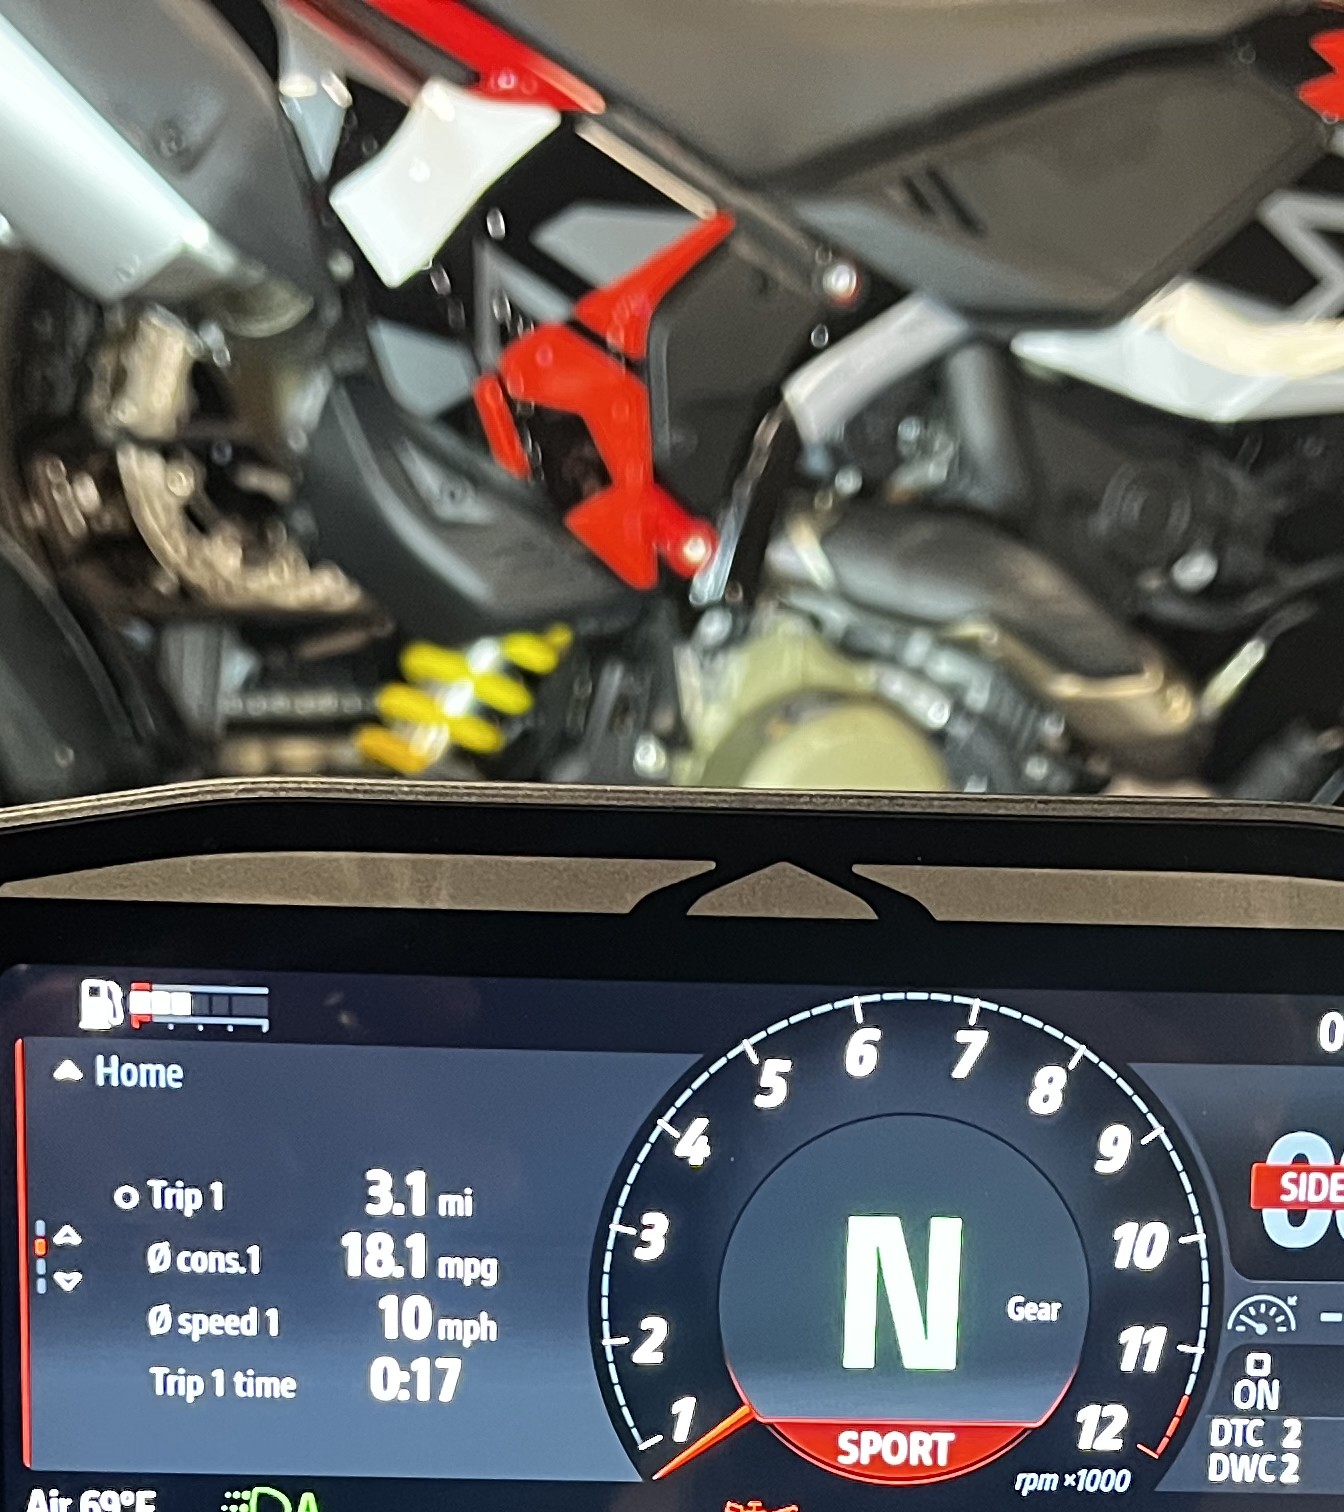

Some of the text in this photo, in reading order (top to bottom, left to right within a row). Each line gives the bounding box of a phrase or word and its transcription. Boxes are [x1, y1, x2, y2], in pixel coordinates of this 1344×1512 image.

[95, 1054, 184, 1089] Home
[845, 1027, 882, 1079] 6
[950, 1029, 990, 1079] 7
[753, 1057, 793, 1110] 5
[1027, 1065, 1068, 1115] 8
[675, 1117, 712, 1167] 4
[1093, 1123, 1132, 1174] 9
[146, 1178, 223, 1218] Trip 1
[364, 1168, 473, 1217] 3.1 mi
[176, 1244, 260, 1275] cons.1
[341, 1231, 498, 1288] 18.1 mpg
[633, 1211, 670, 1262] 3
[1113, 1221, 1172, 1271] 10
[842, 1215, 963, 1371] N
[1006, 1295, 1062, 1322] Gear
[177, 1306, 258, 1343] speed
[264, 1307, 279, 1337] 1
[378, 1294, 498, 1349] 10 mph
[631, 1316, 668, 1366] 2
[1118, 1325, 1168, 1374] 11
[148, 1366, 297, 1404] Trip 1 time
[369, 1355, 462, 1403] 0:17
[1233, 1378, 1280, 1411] ON
[671, 1396, 697, 1443] 1
[1076, 1403, 1129, 1452] 12
[1209, 1417, 1302, 1449] DTC 2
[837, 1431, 957, 1468] SPORT
[1207, 1452, 1301, 1484] DWC 2
[1014, 1472, 1060, 1497] rpm
